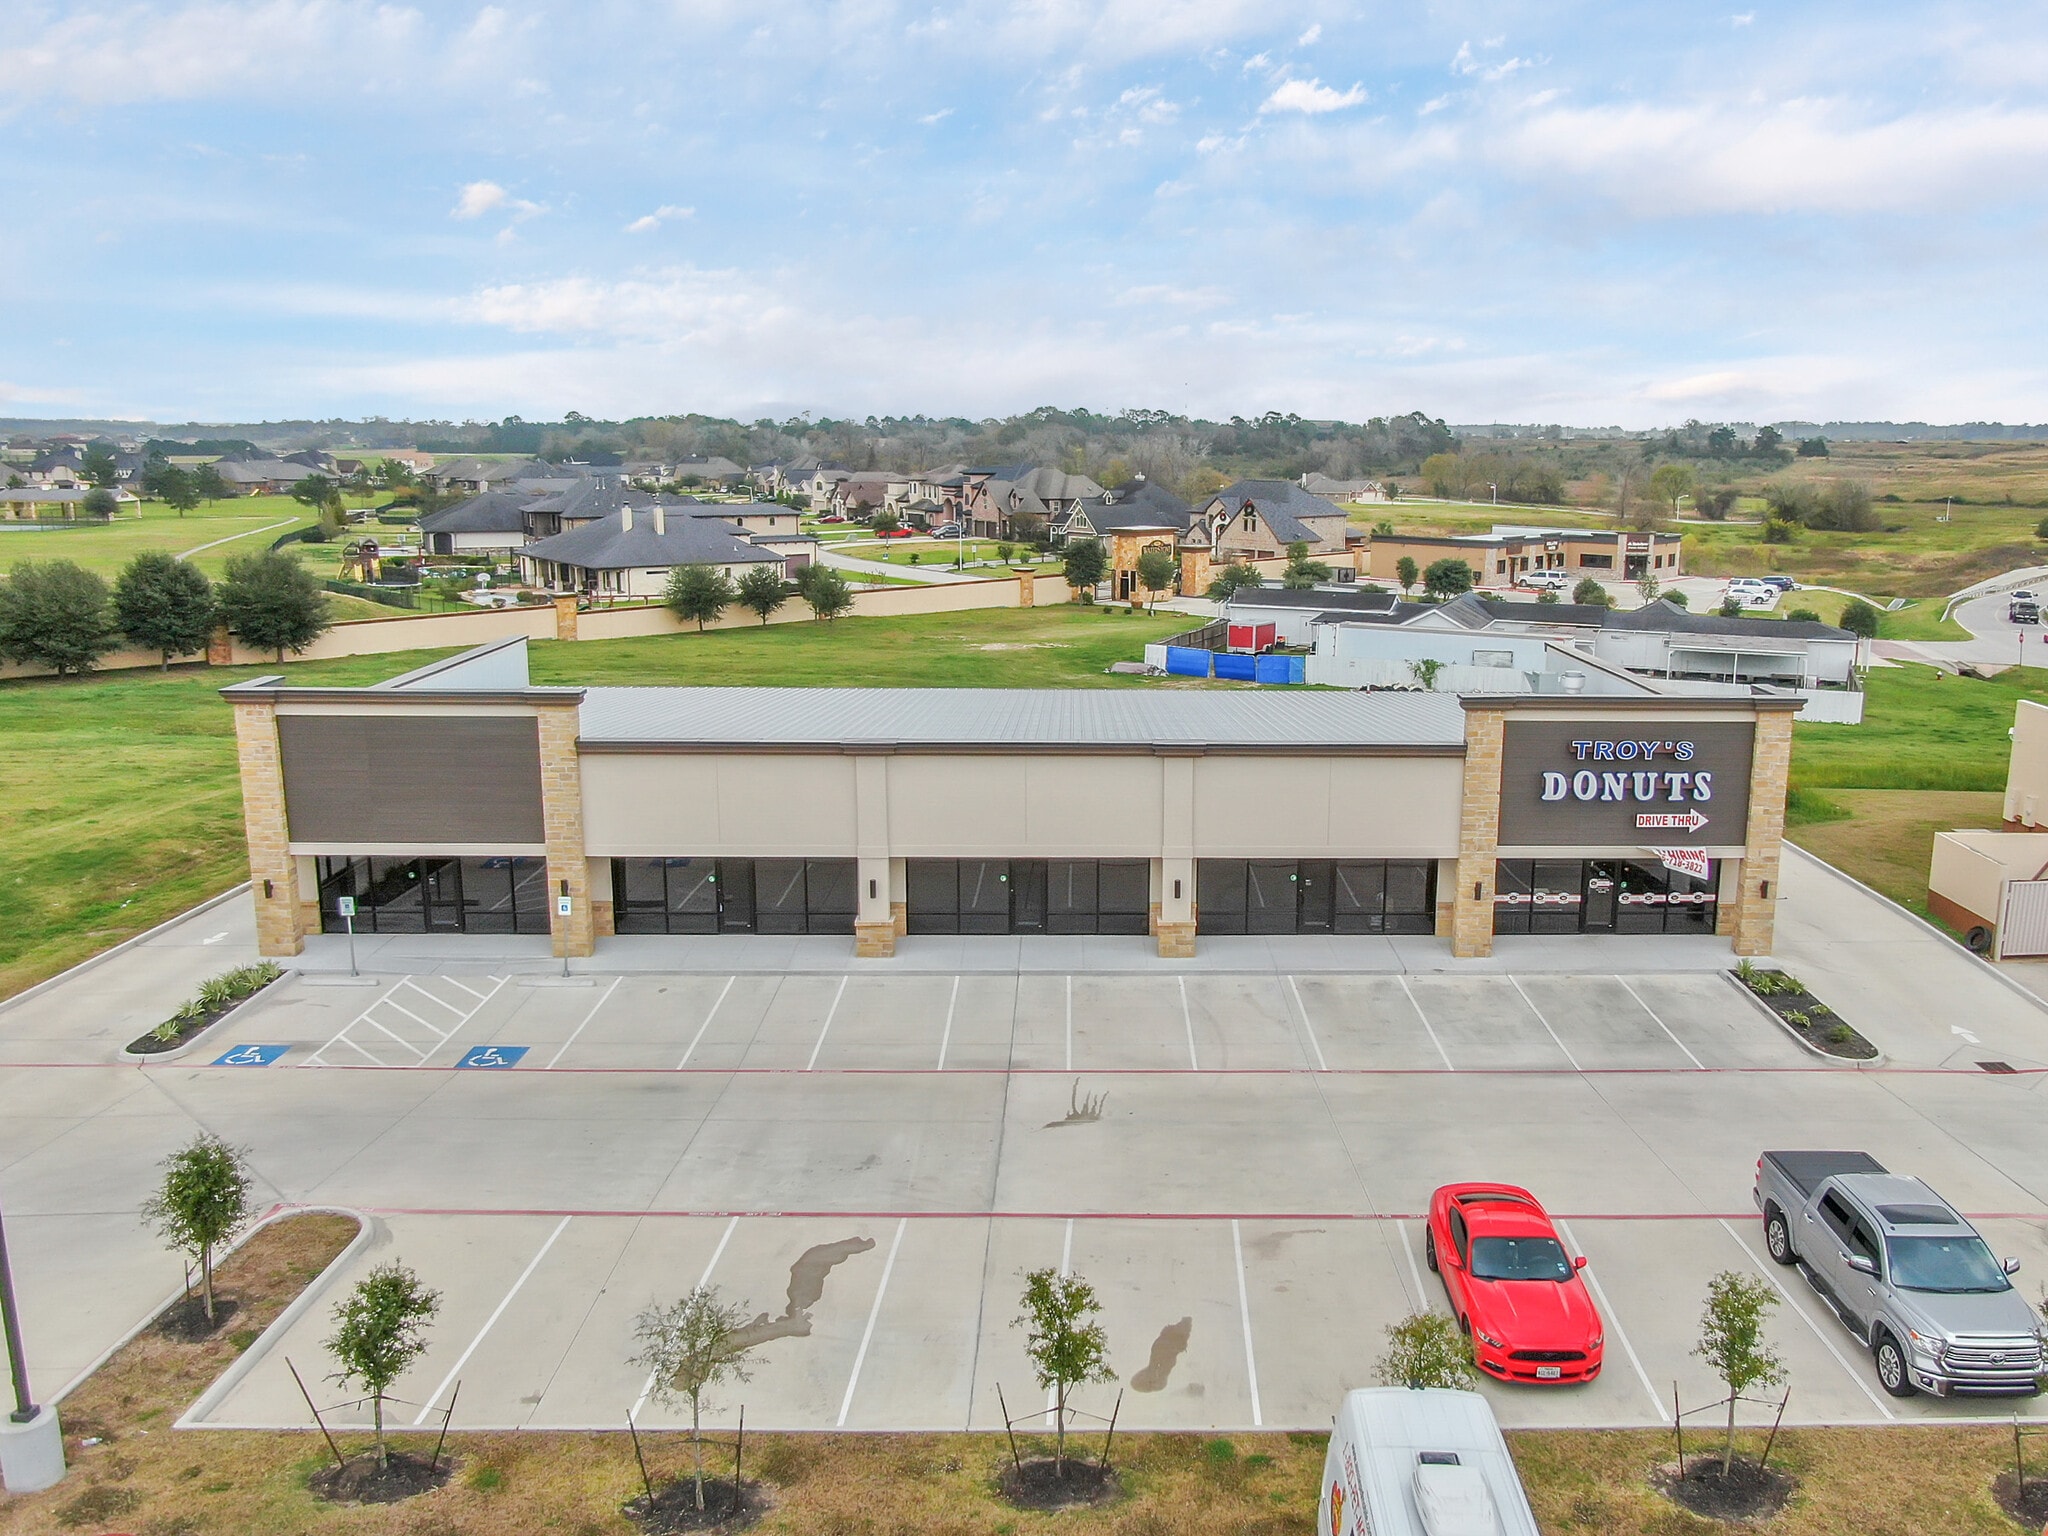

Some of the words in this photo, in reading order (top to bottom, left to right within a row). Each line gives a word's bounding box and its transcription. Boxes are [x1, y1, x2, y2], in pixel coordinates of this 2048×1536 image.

[1572, 740, 1694, 761] TROY'S
[1541, 770, 1711, 801] DONUTS
[1638, 815, 1668, 826] DRIVE
[1671, 815, 1699, 826] THRU
